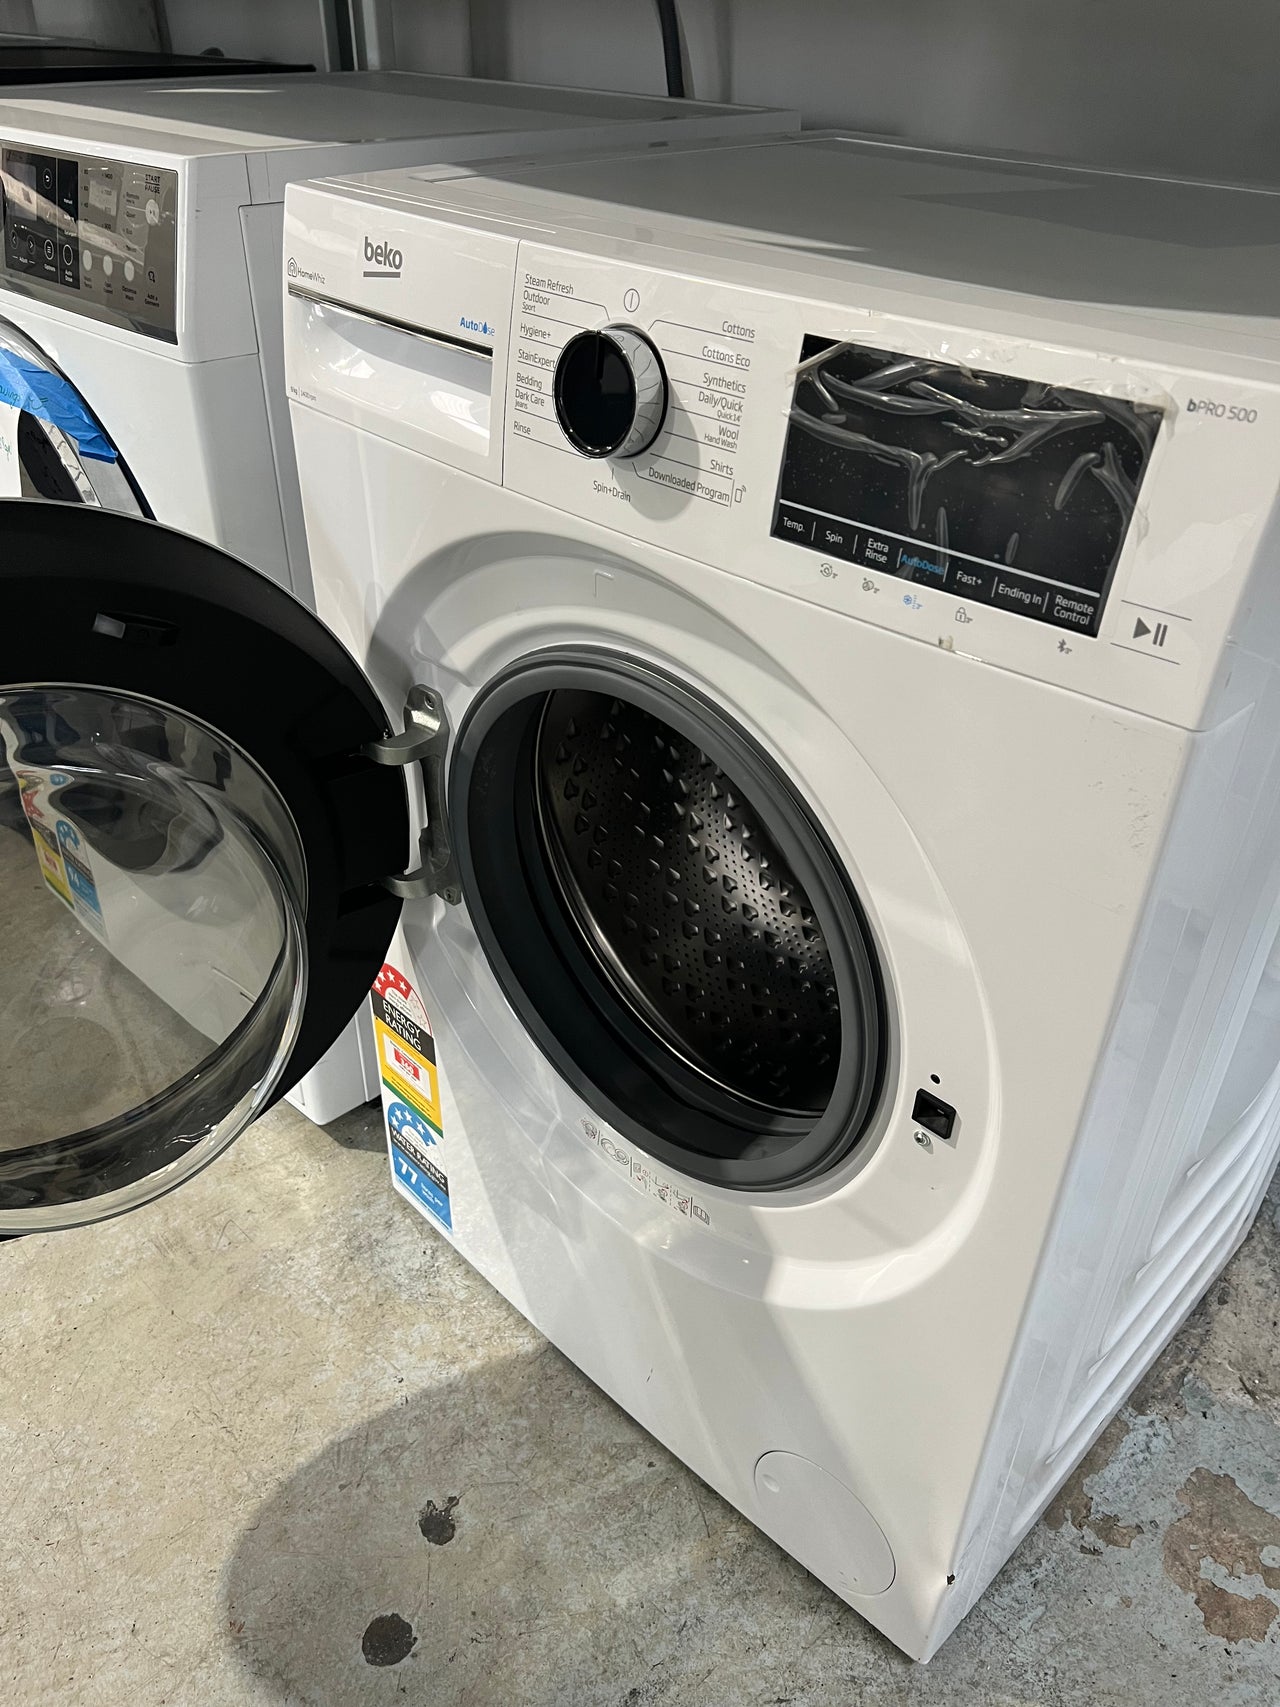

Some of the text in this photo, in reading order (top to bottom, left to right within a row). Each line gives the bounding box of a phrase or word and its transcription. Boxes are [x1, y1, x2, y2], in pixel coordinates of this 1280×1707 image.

[145, 174, 160, 183] START
[364, 236, 403, 270] beko
[297, 267, 326, 285] HomeWhiz
[525, 273, 574, 294] Steam Refresh
[522, 301, 536, 312] Sport
[523, 290, 551, 305] Outdoor
[520, 322, 552, 339] Hygiene+
[722, 320, 756, 339] Cottons
[517, 349, 555, 368] StainExpert
[701, 345, 751, 367] Cottons Eco
[516, 372, 543, 391] Bedding
[702, 372, 747, 394] Synthetics
[514, 399, 528, 409] Jeans
[515, 389, 545, 406] Dark Care
[698, 391, 744, 413] Daily/Quick
[717, 410, 733, 421] Quick
[1186, 398, 1258, 423] bPRO 500
[513, 421, 531, 435] Rinse
[719, 425, 740, 440] Wool
[704, 433, 738, 450] Hand Wash
[709, 459, 734, 476] Shirts
[592, 480, 631, 503] Spin+Drain
[648, 466, 730, 503] Downloaded Program
[783, 517, 806, 533] Temp.
[824, 530, 843, 544] Spin
[867, 538, 889, 553] Extra
[864, 548, 888, 564] Rinse
[900, 554, 946, 575] AutoDose
[956, 571, 983, 586] Fast+
[998, 583, 1042, 605] Ending In
[1054, 595, 1094, 615] Remote
[1053, 606, 1091, 626] Control
[383, 1000, 420, 1038] ENERGY
[385, 1013, 421, 1052] RATING
[398, 1157, 418, 1185] 77
